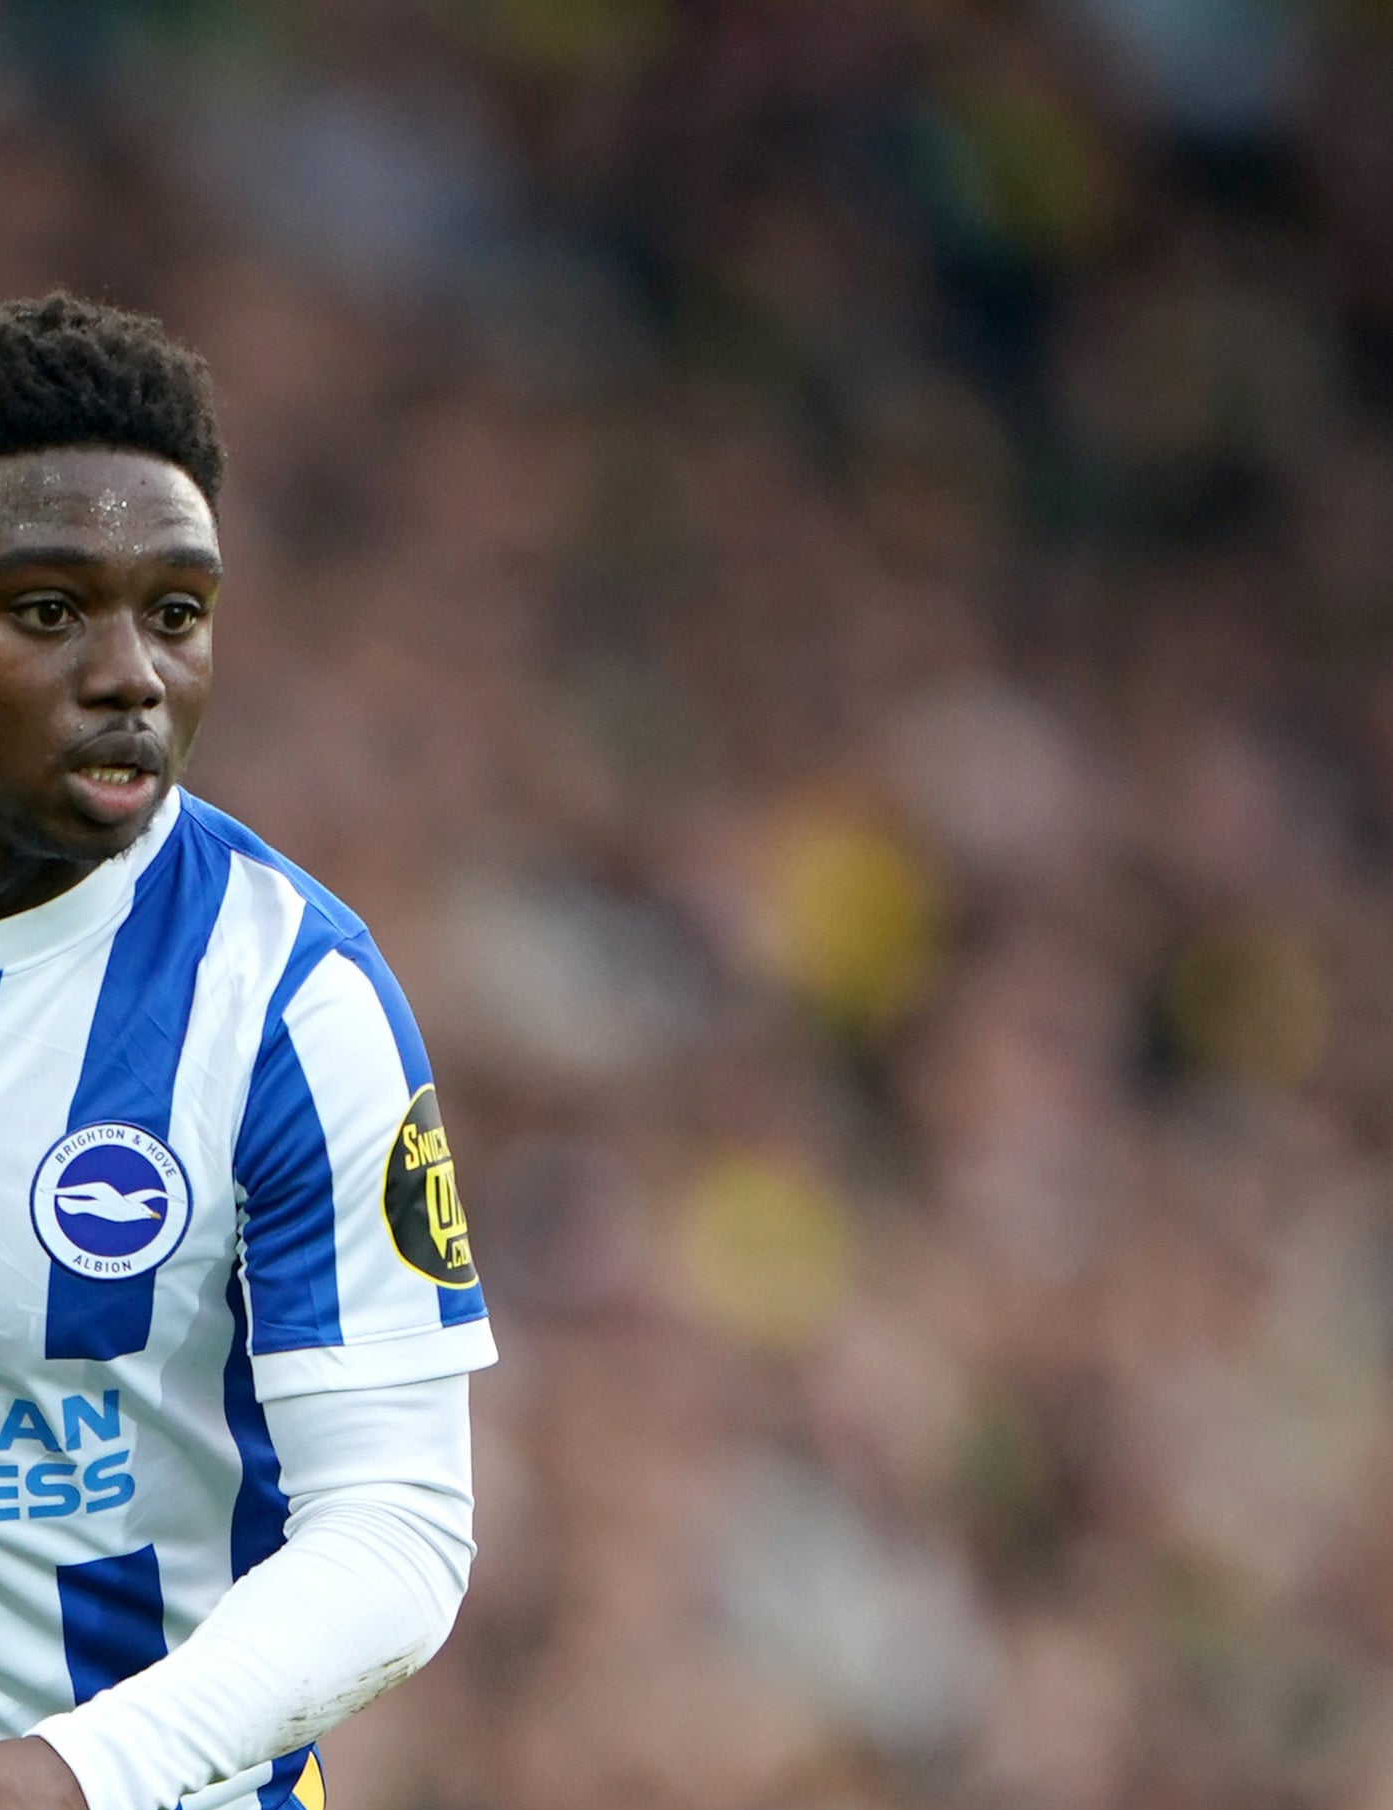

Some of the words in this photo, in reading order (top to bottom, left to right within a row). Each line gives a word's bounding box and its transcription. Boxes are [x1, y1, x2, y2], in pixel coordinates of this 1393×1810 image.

[54, 1127, 126, 1165] BRIGHTON
[132, 1134, 142, 1147] &
[146, 1143, 177, 1179] HOVE
[73, 1254, 133, 1273] ALBION
